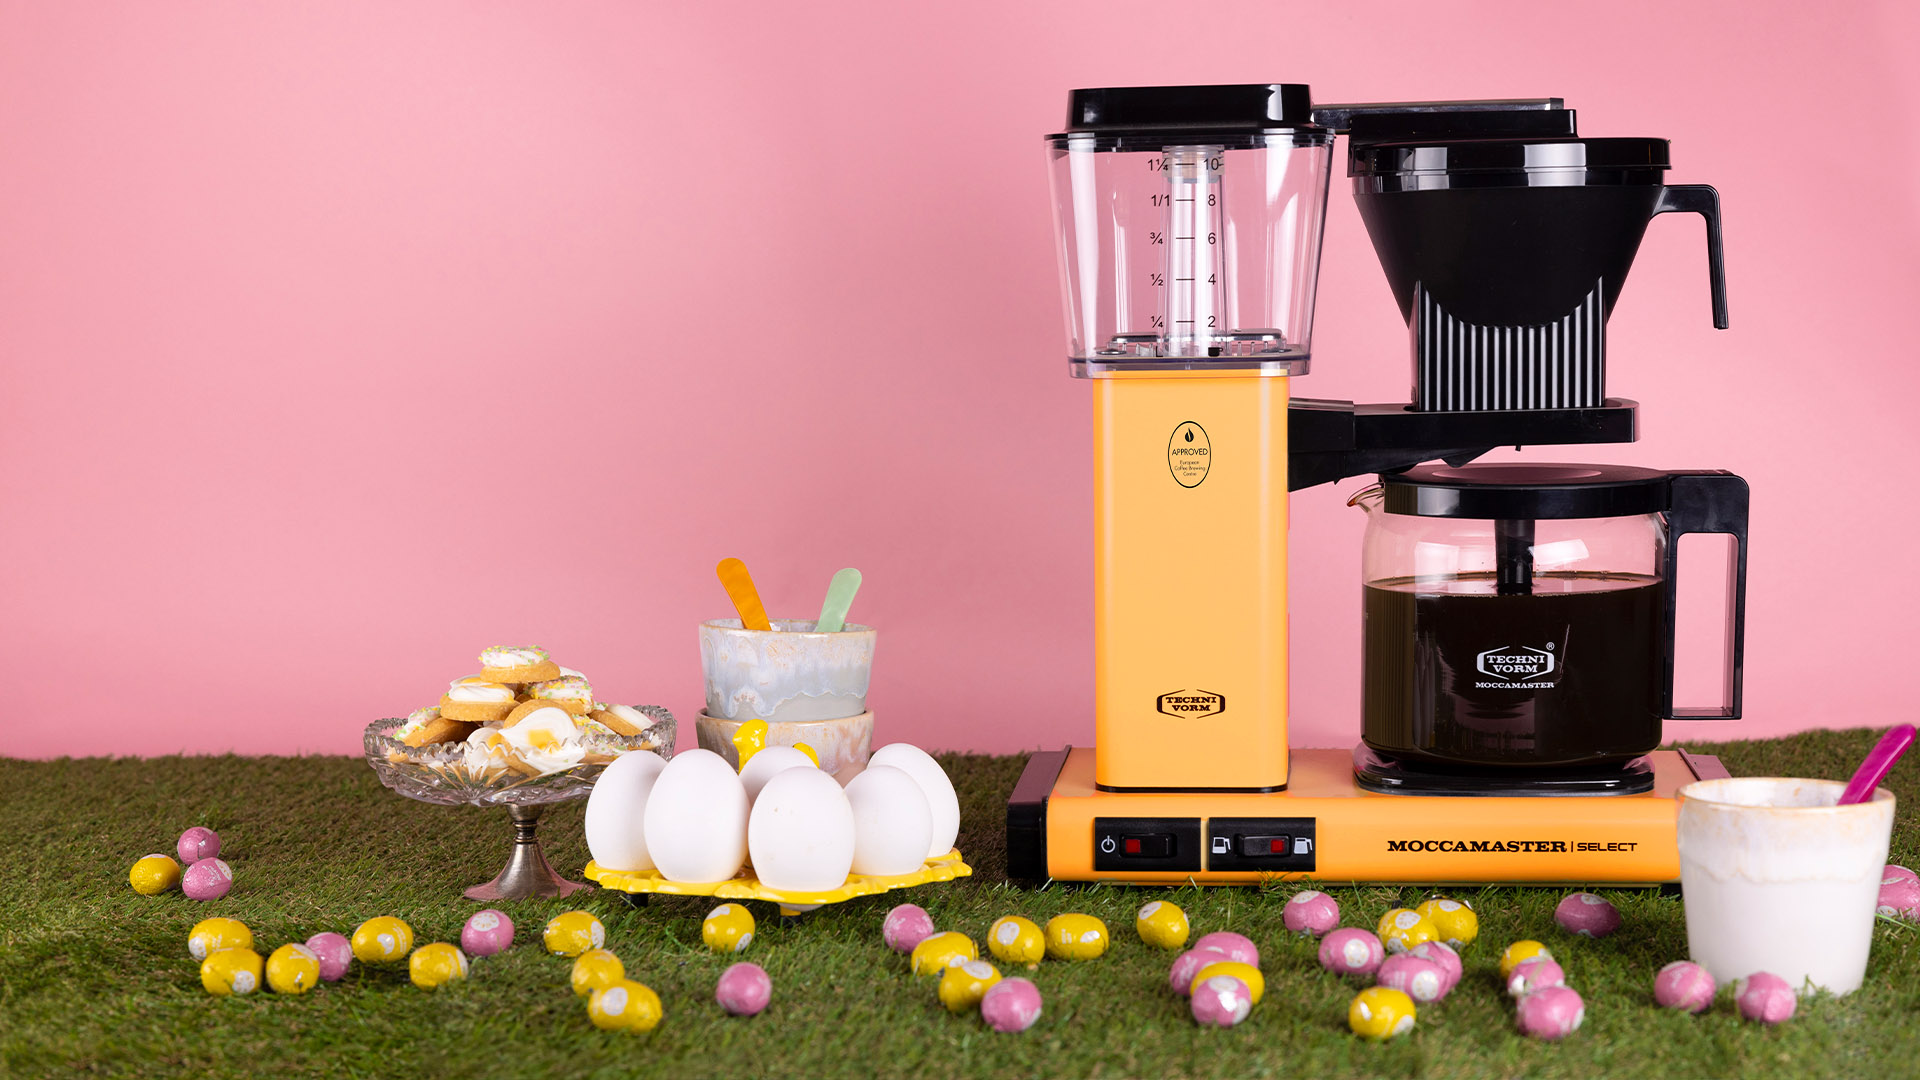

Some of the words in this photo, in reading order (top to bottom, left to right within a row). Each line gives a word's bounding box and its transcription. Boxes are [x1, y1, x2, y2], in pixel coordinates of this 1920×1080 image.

[1203, 158, 1219, 171] 10
[1151, 194, 1171, 207] 1/1
[1207, 194, 1216, 206] 8
[1207, 233, 1216, 245] 6
[1207, 273, 1217, 285] 4
[1207, 316, 1216, 328] 2
[1171, 448, 1209, 456] APPROVED
[1486, 655, 1545, 664] TECHNI
[1493, 664, 1538, 673] VORM
[1165, 696, 1217, 704] TECHNI
[1172, 704, 1211, 712] VORM
[1387, 840, 1567, 853] MOCCAMASTER
[1576, 842, 1638, 852] SELECT
